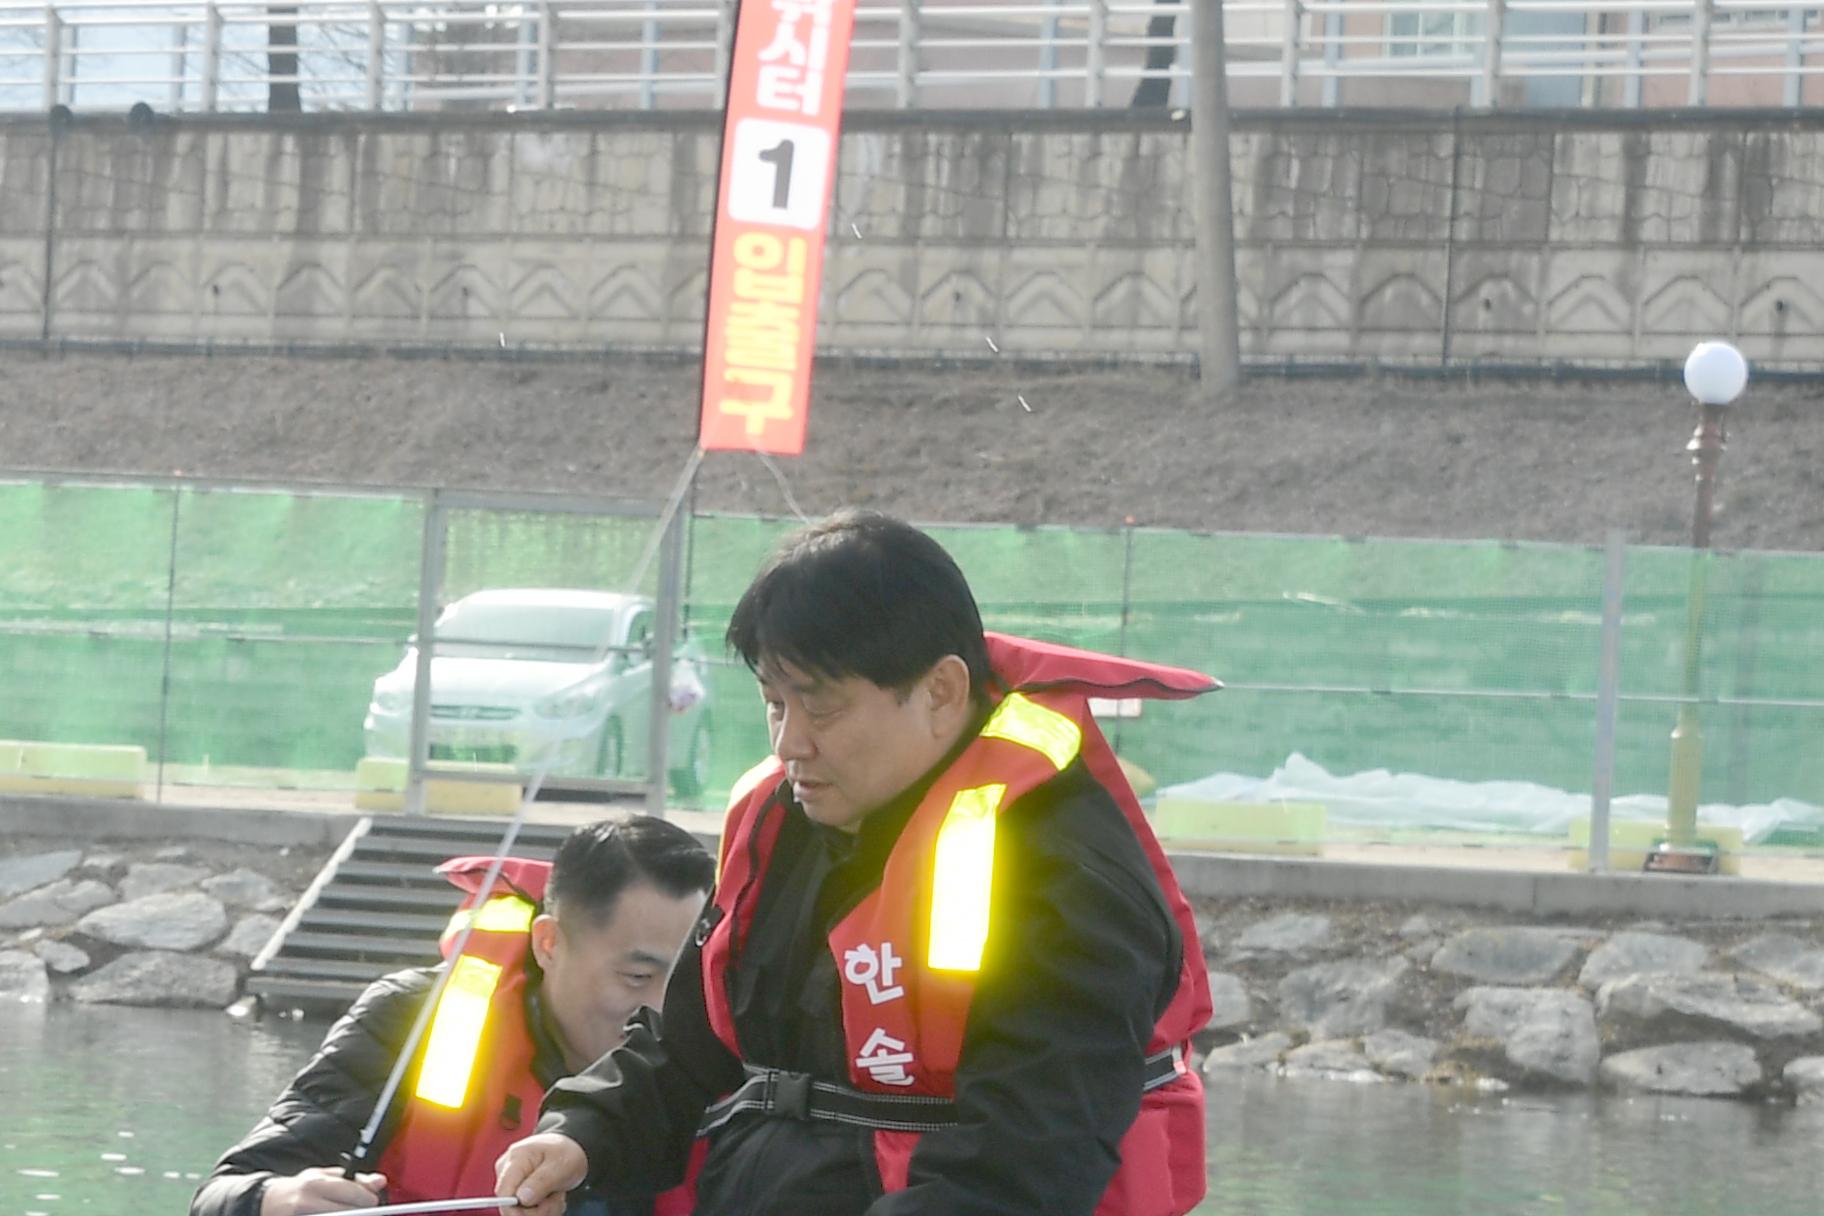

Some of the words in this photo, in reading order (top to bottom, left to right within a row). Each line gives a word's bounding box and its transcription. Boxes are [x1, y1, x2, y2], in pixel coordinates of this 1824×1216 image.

[756, 0, 833, 116] 시터
[758, 138, 795, 210] 1
[719, 231, 808, 436] 입출구
